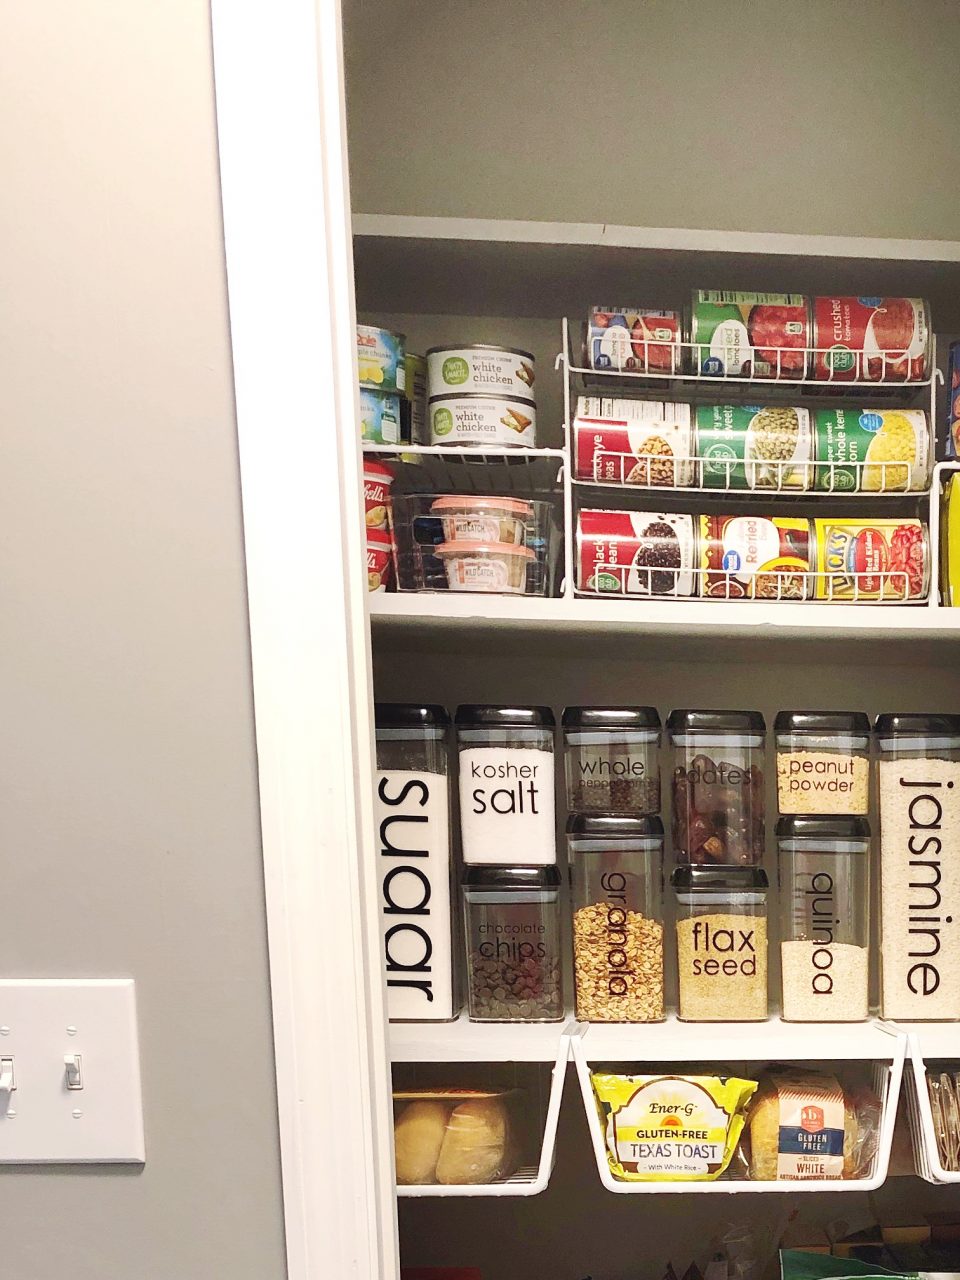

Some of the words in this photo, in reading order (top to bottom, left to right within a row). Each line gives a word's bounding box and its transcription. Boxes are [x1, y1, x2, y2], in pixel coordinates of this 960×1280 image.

[831, 300, 843, 342] crushed
[472, 364, 502, 374] white
[473, 374, 513, 385] chicken
[455, 412, 484, 423] white
[455, 422, 497, 433] chicken
[834, 431, 846, 466] whole
[846, 440, 858, 466] corn
[864, 531, 875, 555] Kidney
[865, 557, 874, 571] Red
[872, 550, 880, 572] Beans
[478, 569, 494, 578] CATCH
[471, 761, 539, 778] kosher
[578, 756, 645, 775] whole
[789, 759, 855, 777] peanut
[687, 766, 752, 785] dates
[789, 778, 855, 793] powder
[473, 781, 539, 814] salt
[899, 776, 954, 997] jasmine
[478, 922, 546, 934] chocolate
[601, 872, 636, 997] granola
[805, 872, 841, 995] quinoa
[692, 922, 756, 952] flax
[478, 938, 547, 962] chips
[692, 954, 757, 977] seed
[649, 1102, 694, 1117] Ener-G
[636, 1129, 709, 1140] GLUTEN-FREE
[797, 1133, 828, 1143] GLUTEN
[630, 1143, 672, 1159] TEXAS
[673, 1143, 718, 1159] TOAST
[803, 1142, 822, 1151] FREE
[648, 1163, 663, 1171] With
[664, 1163, 683, 1171] White
[684, 1164, 697, 1172] Rice
[796, 1163, 825, 1174] WHITE
